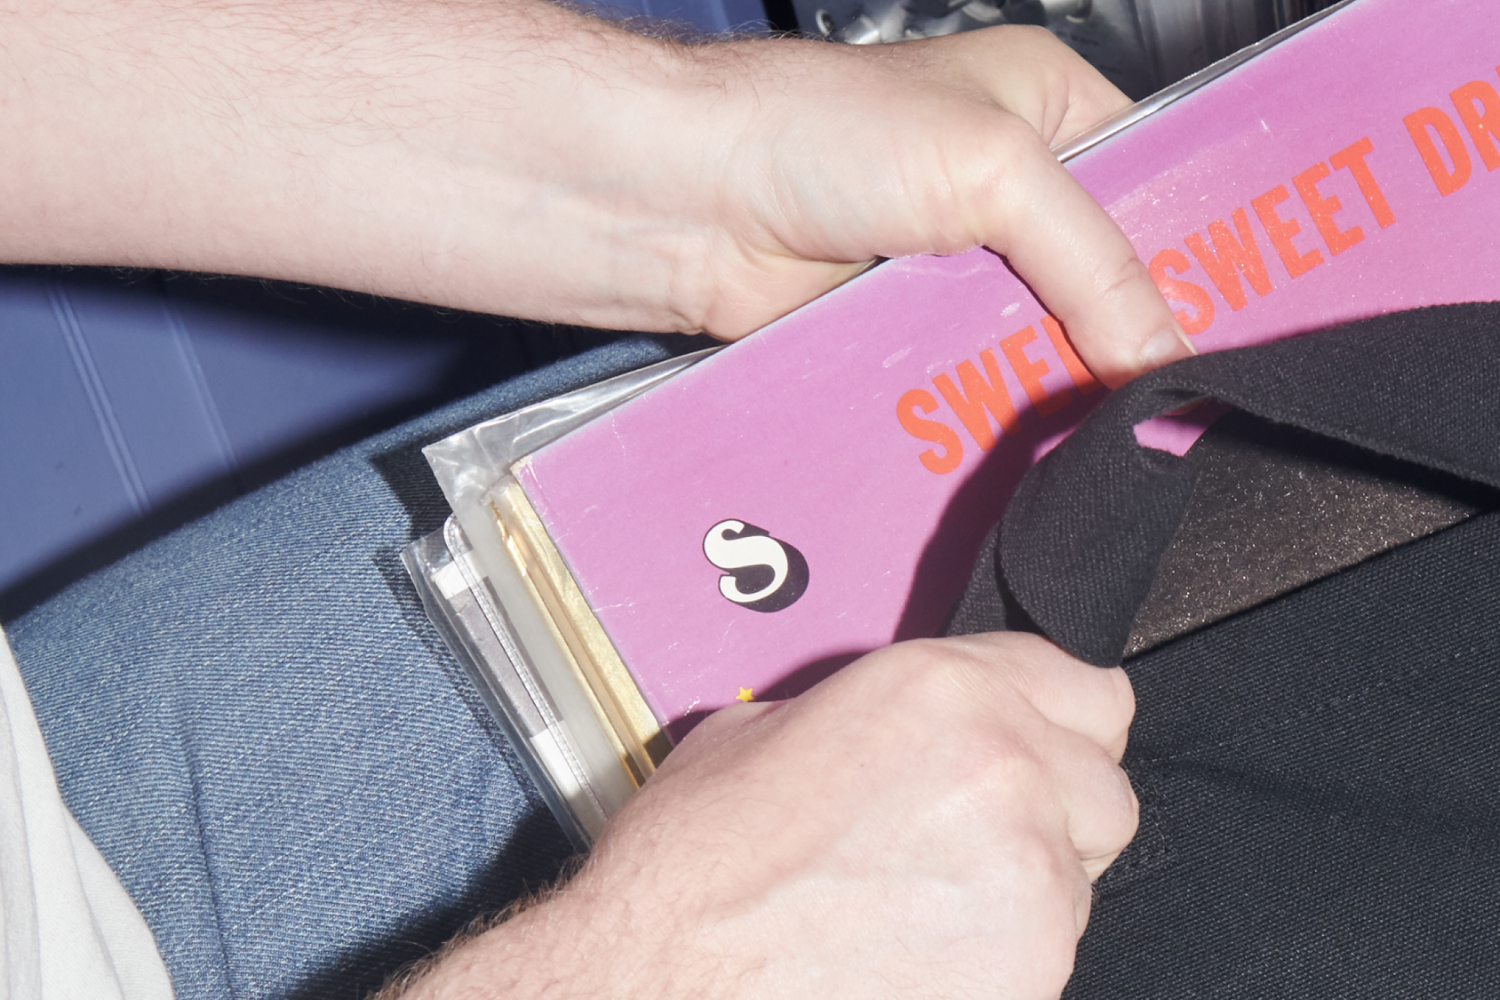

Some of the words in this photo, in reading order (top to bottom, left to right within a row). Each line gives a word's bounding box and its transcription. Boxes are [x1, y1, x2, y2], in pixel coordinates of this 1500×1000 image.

[896, 315, 1103, 475] SWE
[1148, 136, 1396, 335] SWEET
[704, 519, 798, 606] S
